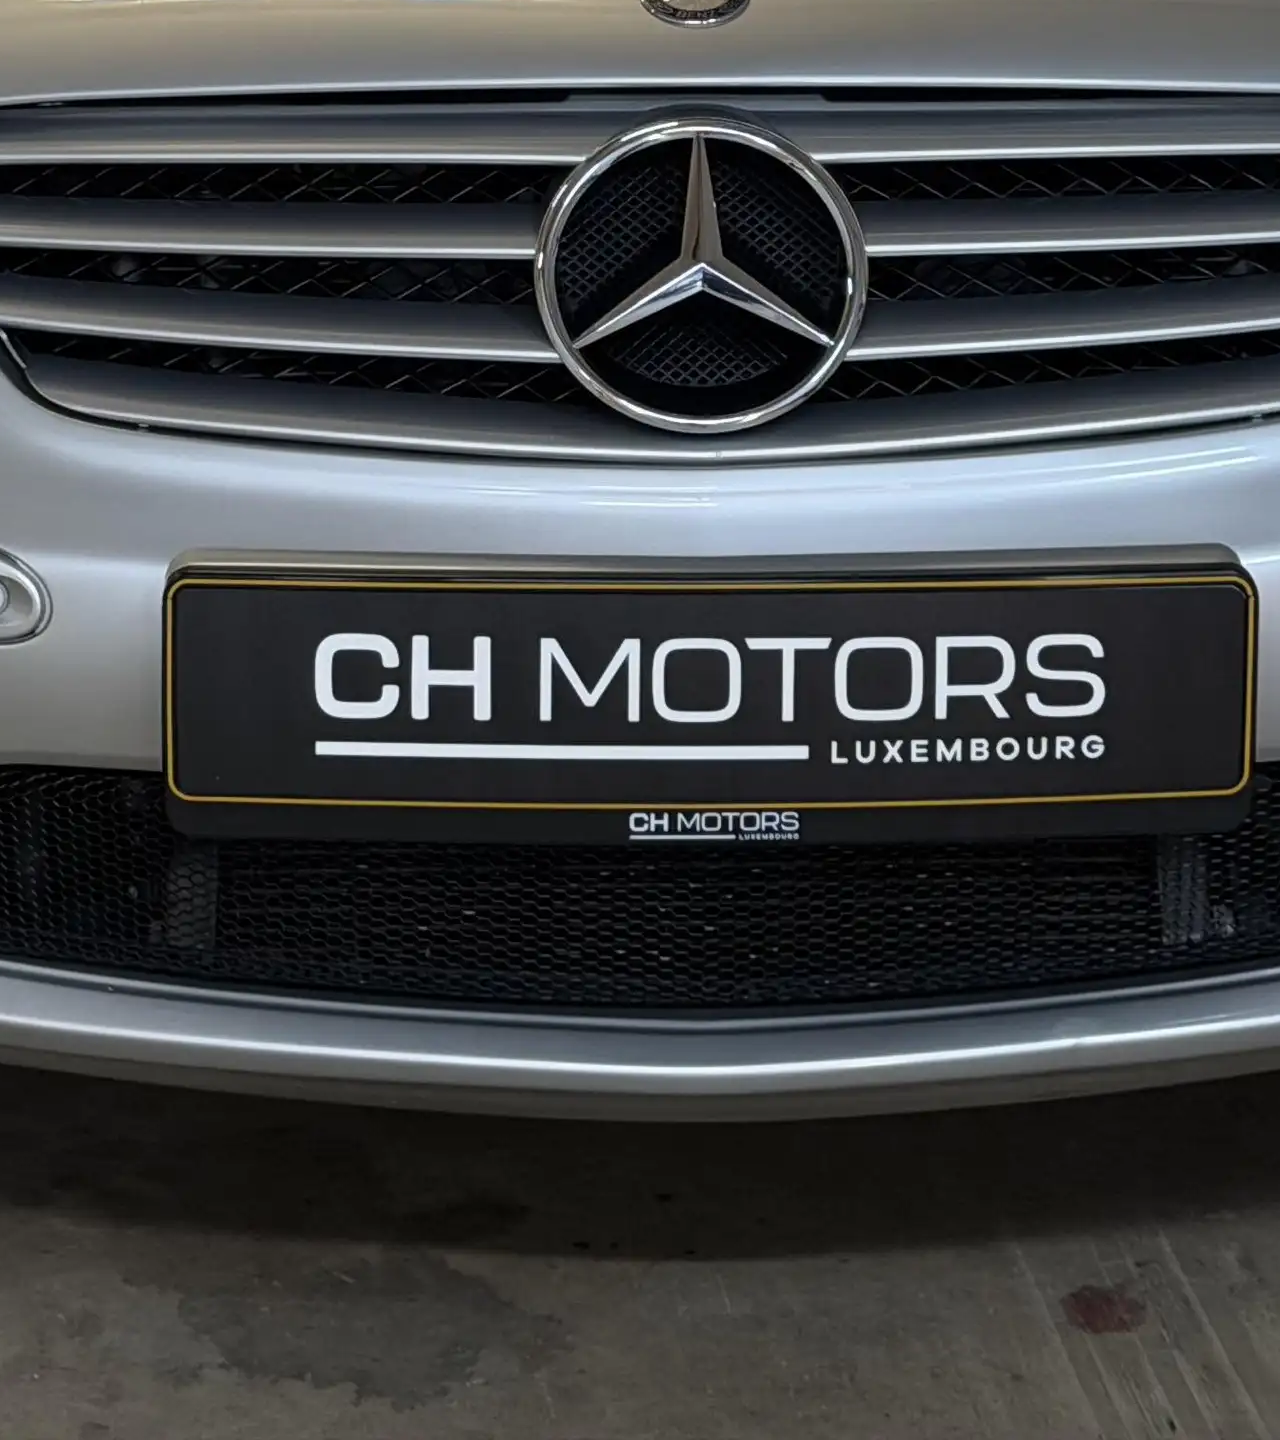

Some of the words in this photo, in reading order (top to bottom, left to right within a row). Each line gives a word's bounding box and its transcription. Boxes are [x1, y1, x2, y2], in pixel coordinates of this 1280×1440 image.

[314, 632, 492, 722] CH
[539, 633, 1106, 723] MOTORS
[830, 734, 1106, 764] LUXEMBOURG
[629, 812, 669, 832] CH
[677, 811, 800, 832] MOTORS
